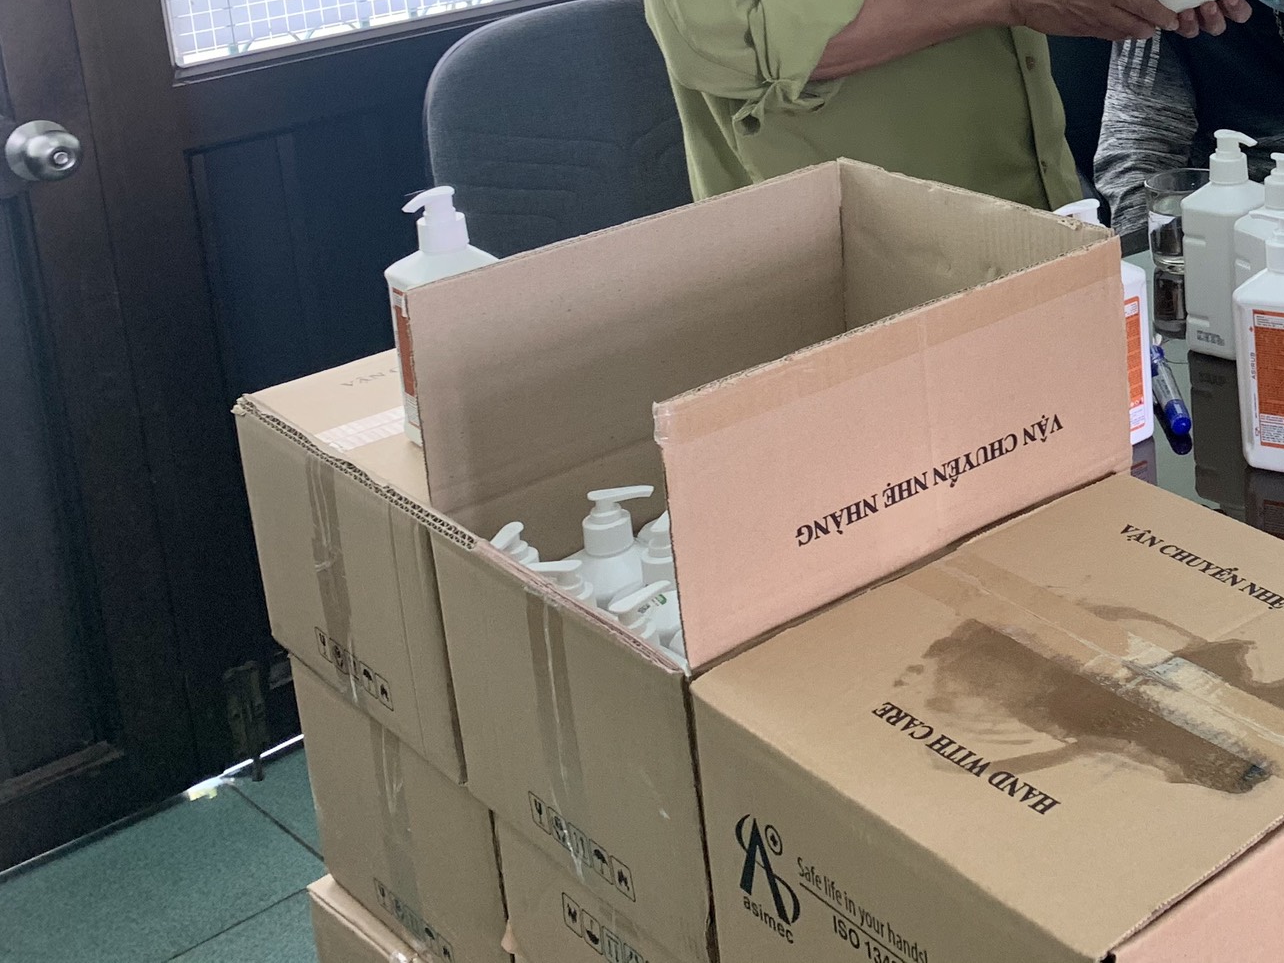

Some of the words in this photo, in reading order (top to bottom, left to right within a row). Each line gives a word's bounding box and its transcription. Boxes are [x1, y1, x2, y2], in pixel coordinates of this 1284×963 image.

[1022, 413, 1064, 446] VẬN
[933, 433, 1018, 488] CHUYỂN
[882, 471, 929, 509] NHẸ
[795, 493, 879, 547] NHÀNG
[1119, 524, 1164, 548] VẬN
[1159, 544, 1244, 587] CHUYỂN
[871, 701, 934, 740] CARE
[925, 734, 991, 777] WITH
[987, 771, 1062, 815] HAND
[797, 856, 822, 885] Safe
[824, 875, 842, 906] life
[844, 891, 857, 917] in
[858, 905, 885, 938] your
[743, 896, 794, 944] asimec
[833, 915, 860, 949] ISO
